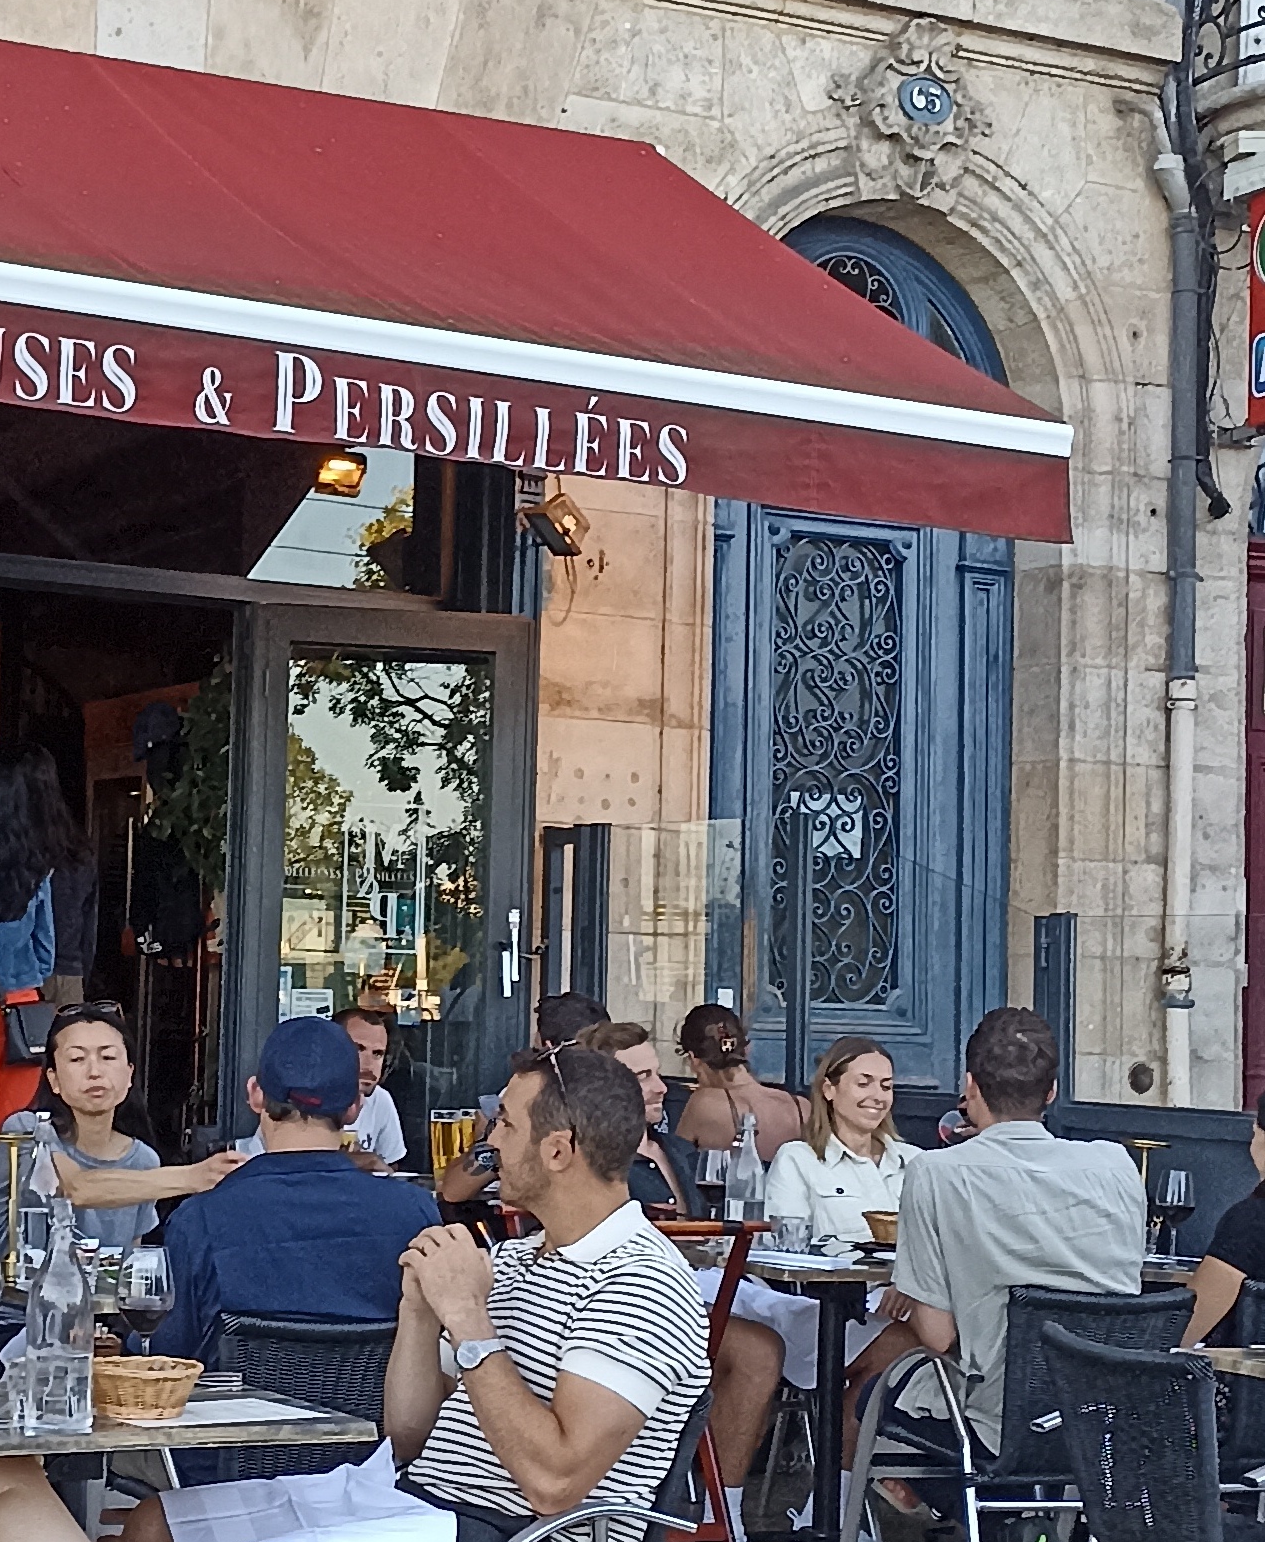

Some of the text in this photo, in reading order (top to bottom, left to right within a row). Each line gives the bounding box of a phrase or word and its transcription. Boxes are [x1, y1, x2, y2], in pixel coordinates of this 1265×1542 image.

[912, 86, 942, 113] 65
[195, 366, 233, 427] &
[273, 350, 689, 486] PERSILLÉES
